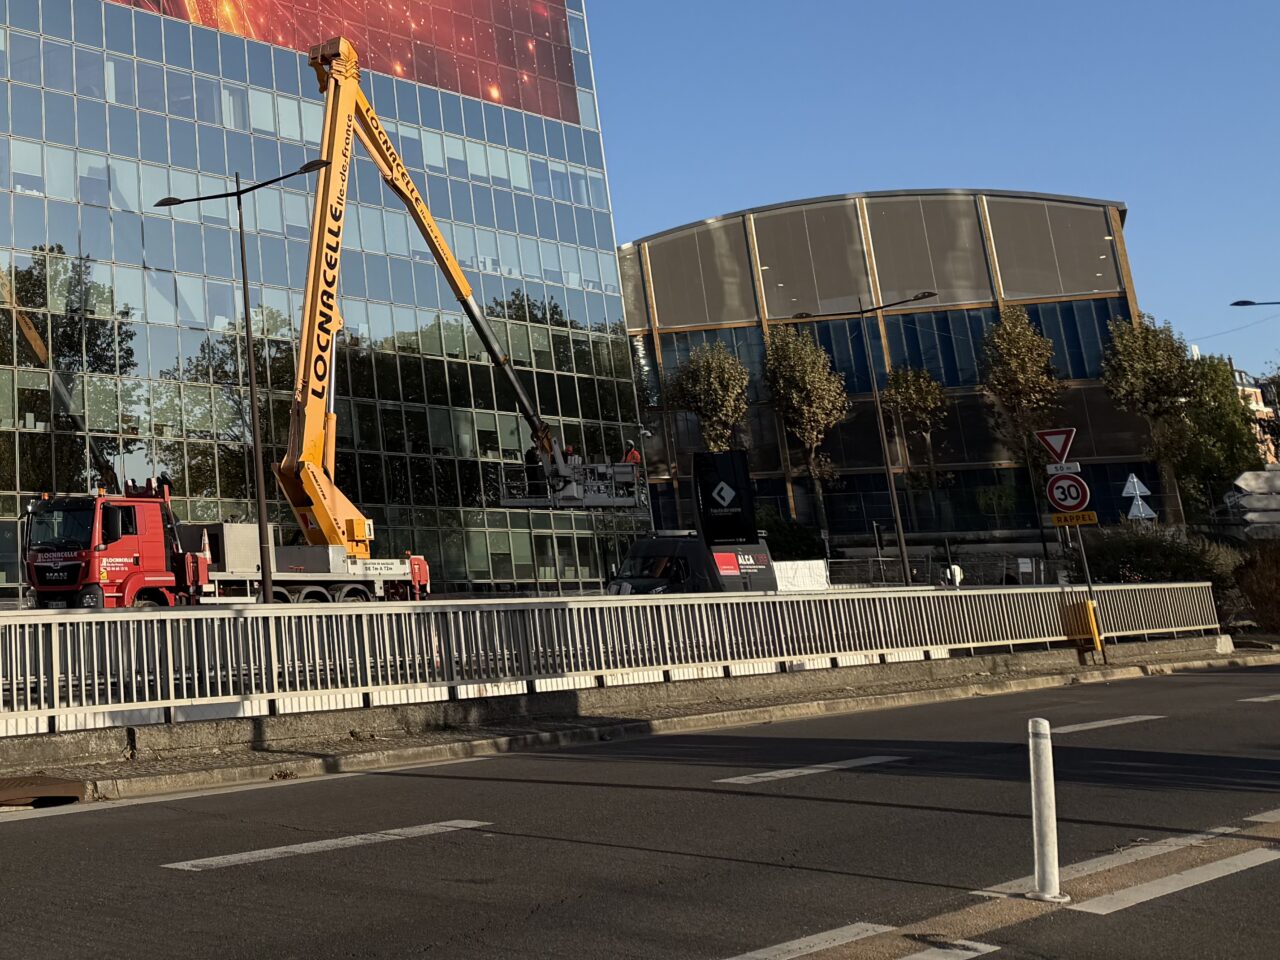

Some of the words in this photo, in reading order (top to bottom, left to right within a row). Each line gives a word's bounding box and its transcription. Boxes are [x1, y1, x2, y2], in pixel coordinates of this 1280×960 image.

[365, 107, 422, 208] LOCNACELLE
[311, 204, 343, 400] LOCNACELLE
[1055, 484, 1080, 502] 30
[1056, 513, 1094, 524] RAPPEL
